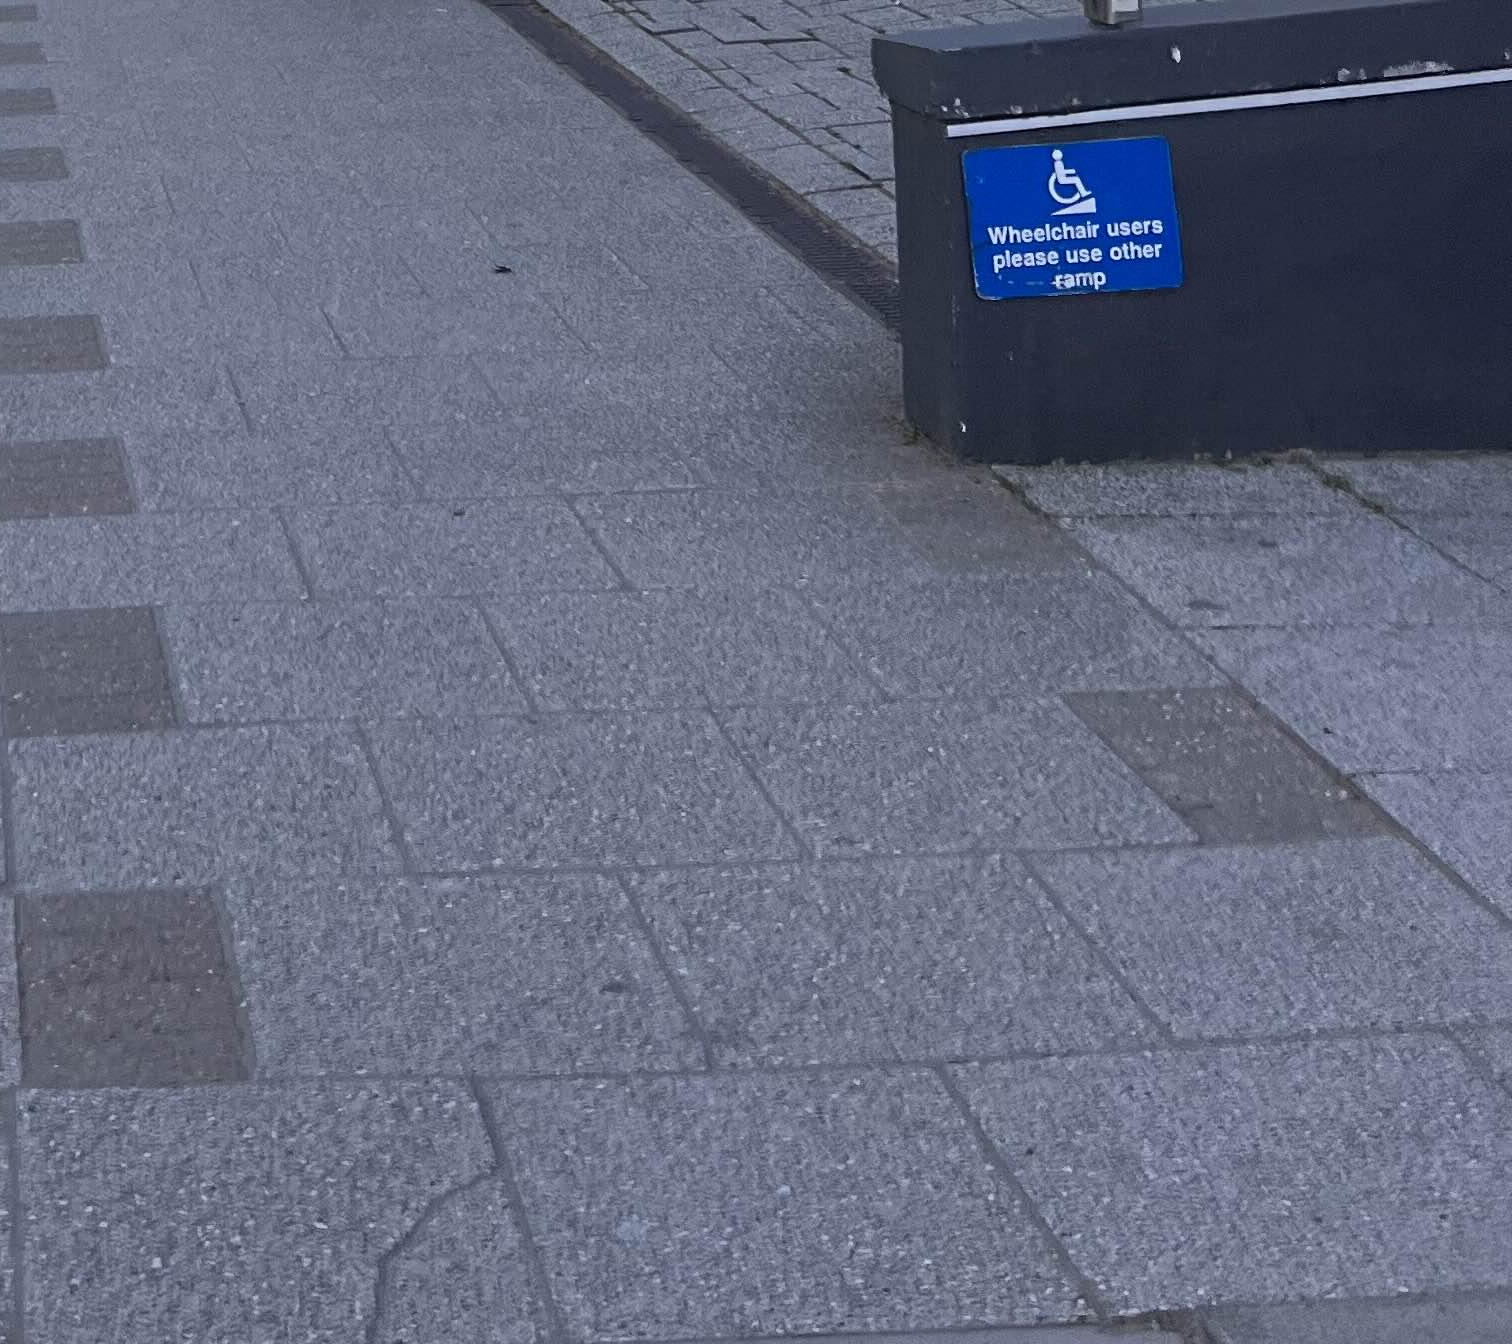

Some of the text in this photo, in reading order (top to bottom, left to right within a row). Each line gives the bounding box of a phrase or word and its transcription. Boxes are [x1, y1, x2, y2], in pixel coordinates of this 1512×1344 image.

[988, 219, 1163, 244] Wheelchair users
[993, 241, 1162, 273] please use other
[1055, 271, 1106, 289] ramp
